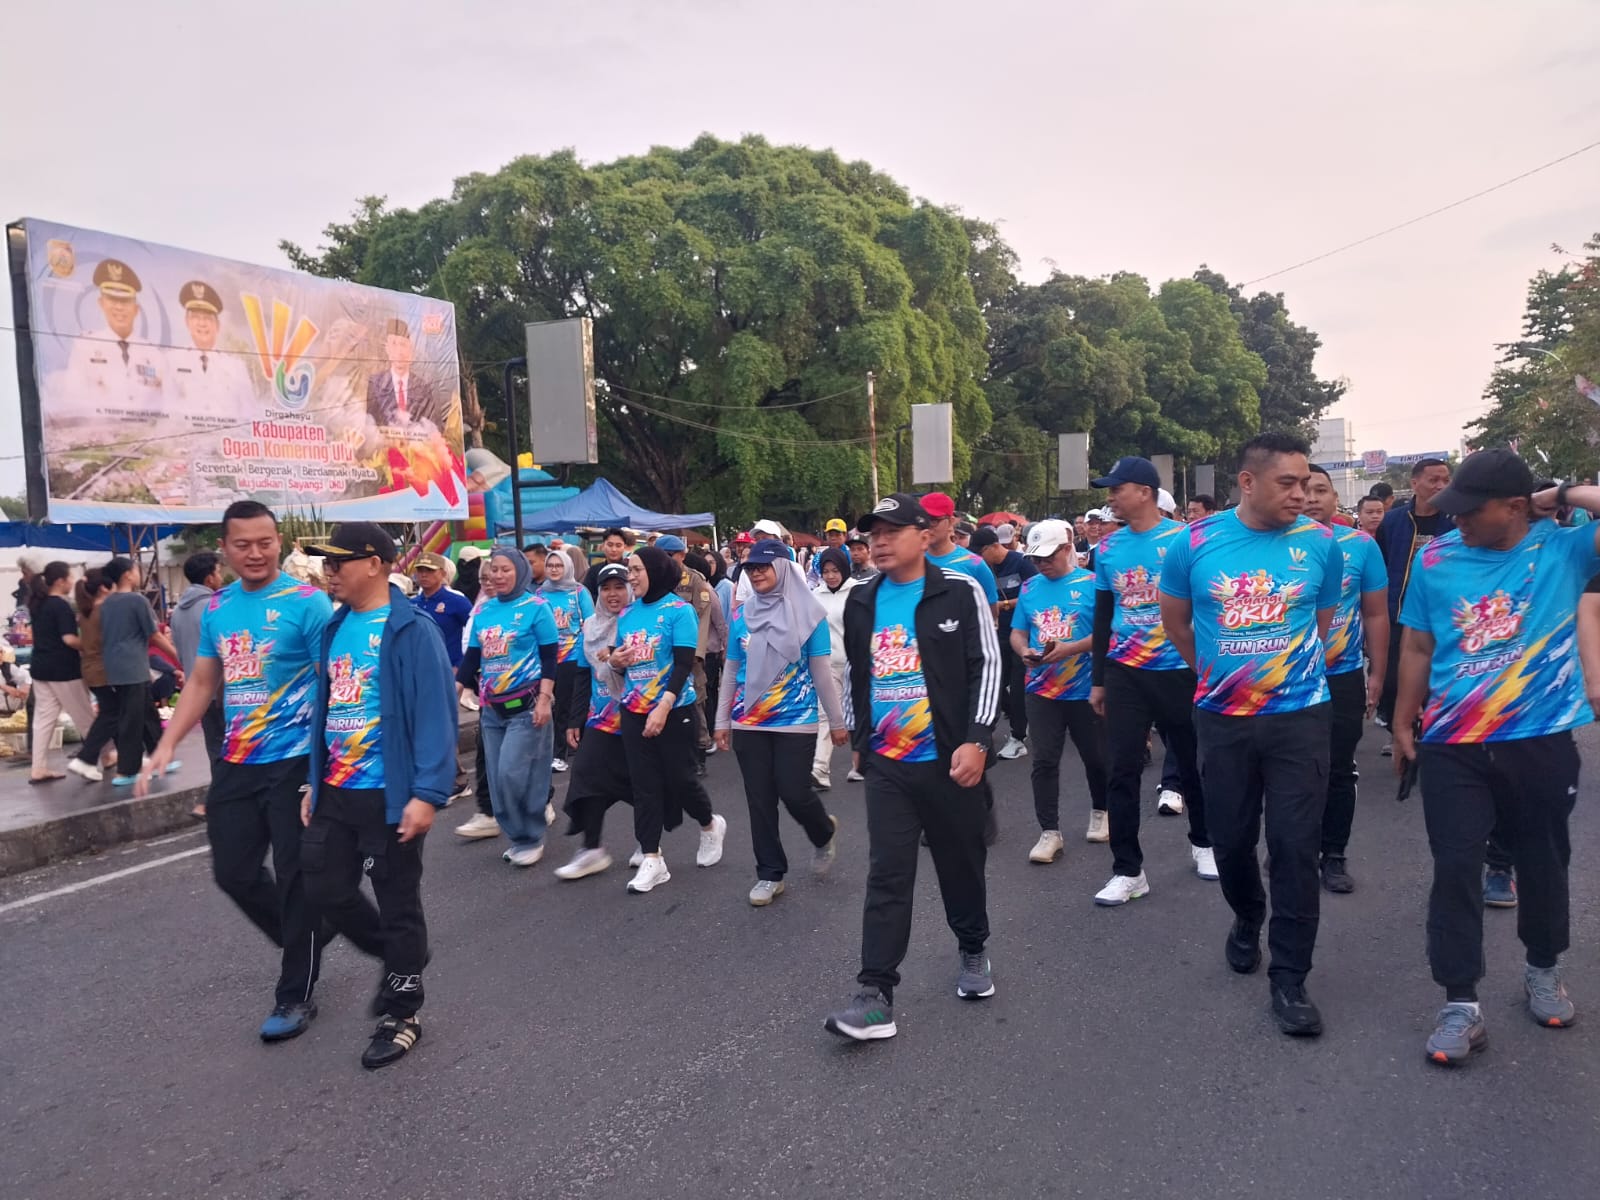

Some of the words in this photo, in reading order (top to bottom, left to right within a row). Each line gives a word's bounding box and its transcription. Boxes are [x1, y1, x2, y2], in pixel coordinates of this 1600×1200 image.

[252, 421, 324, 442] Kabupaten
[223, 437, 260, 459] Ogan
[263, 439, 329, 463] Komering
[195, 462, 243, 474] Serentak
[1219, 640, 1253, 656] FUN
[1255, 637, 1290, 653] RUN
[242, 691, 269, 705] RUN
[329, 685, 361, 704] KU
[898, 686, 928, 700] RUN
[338, 718, 366, 732] RUN
